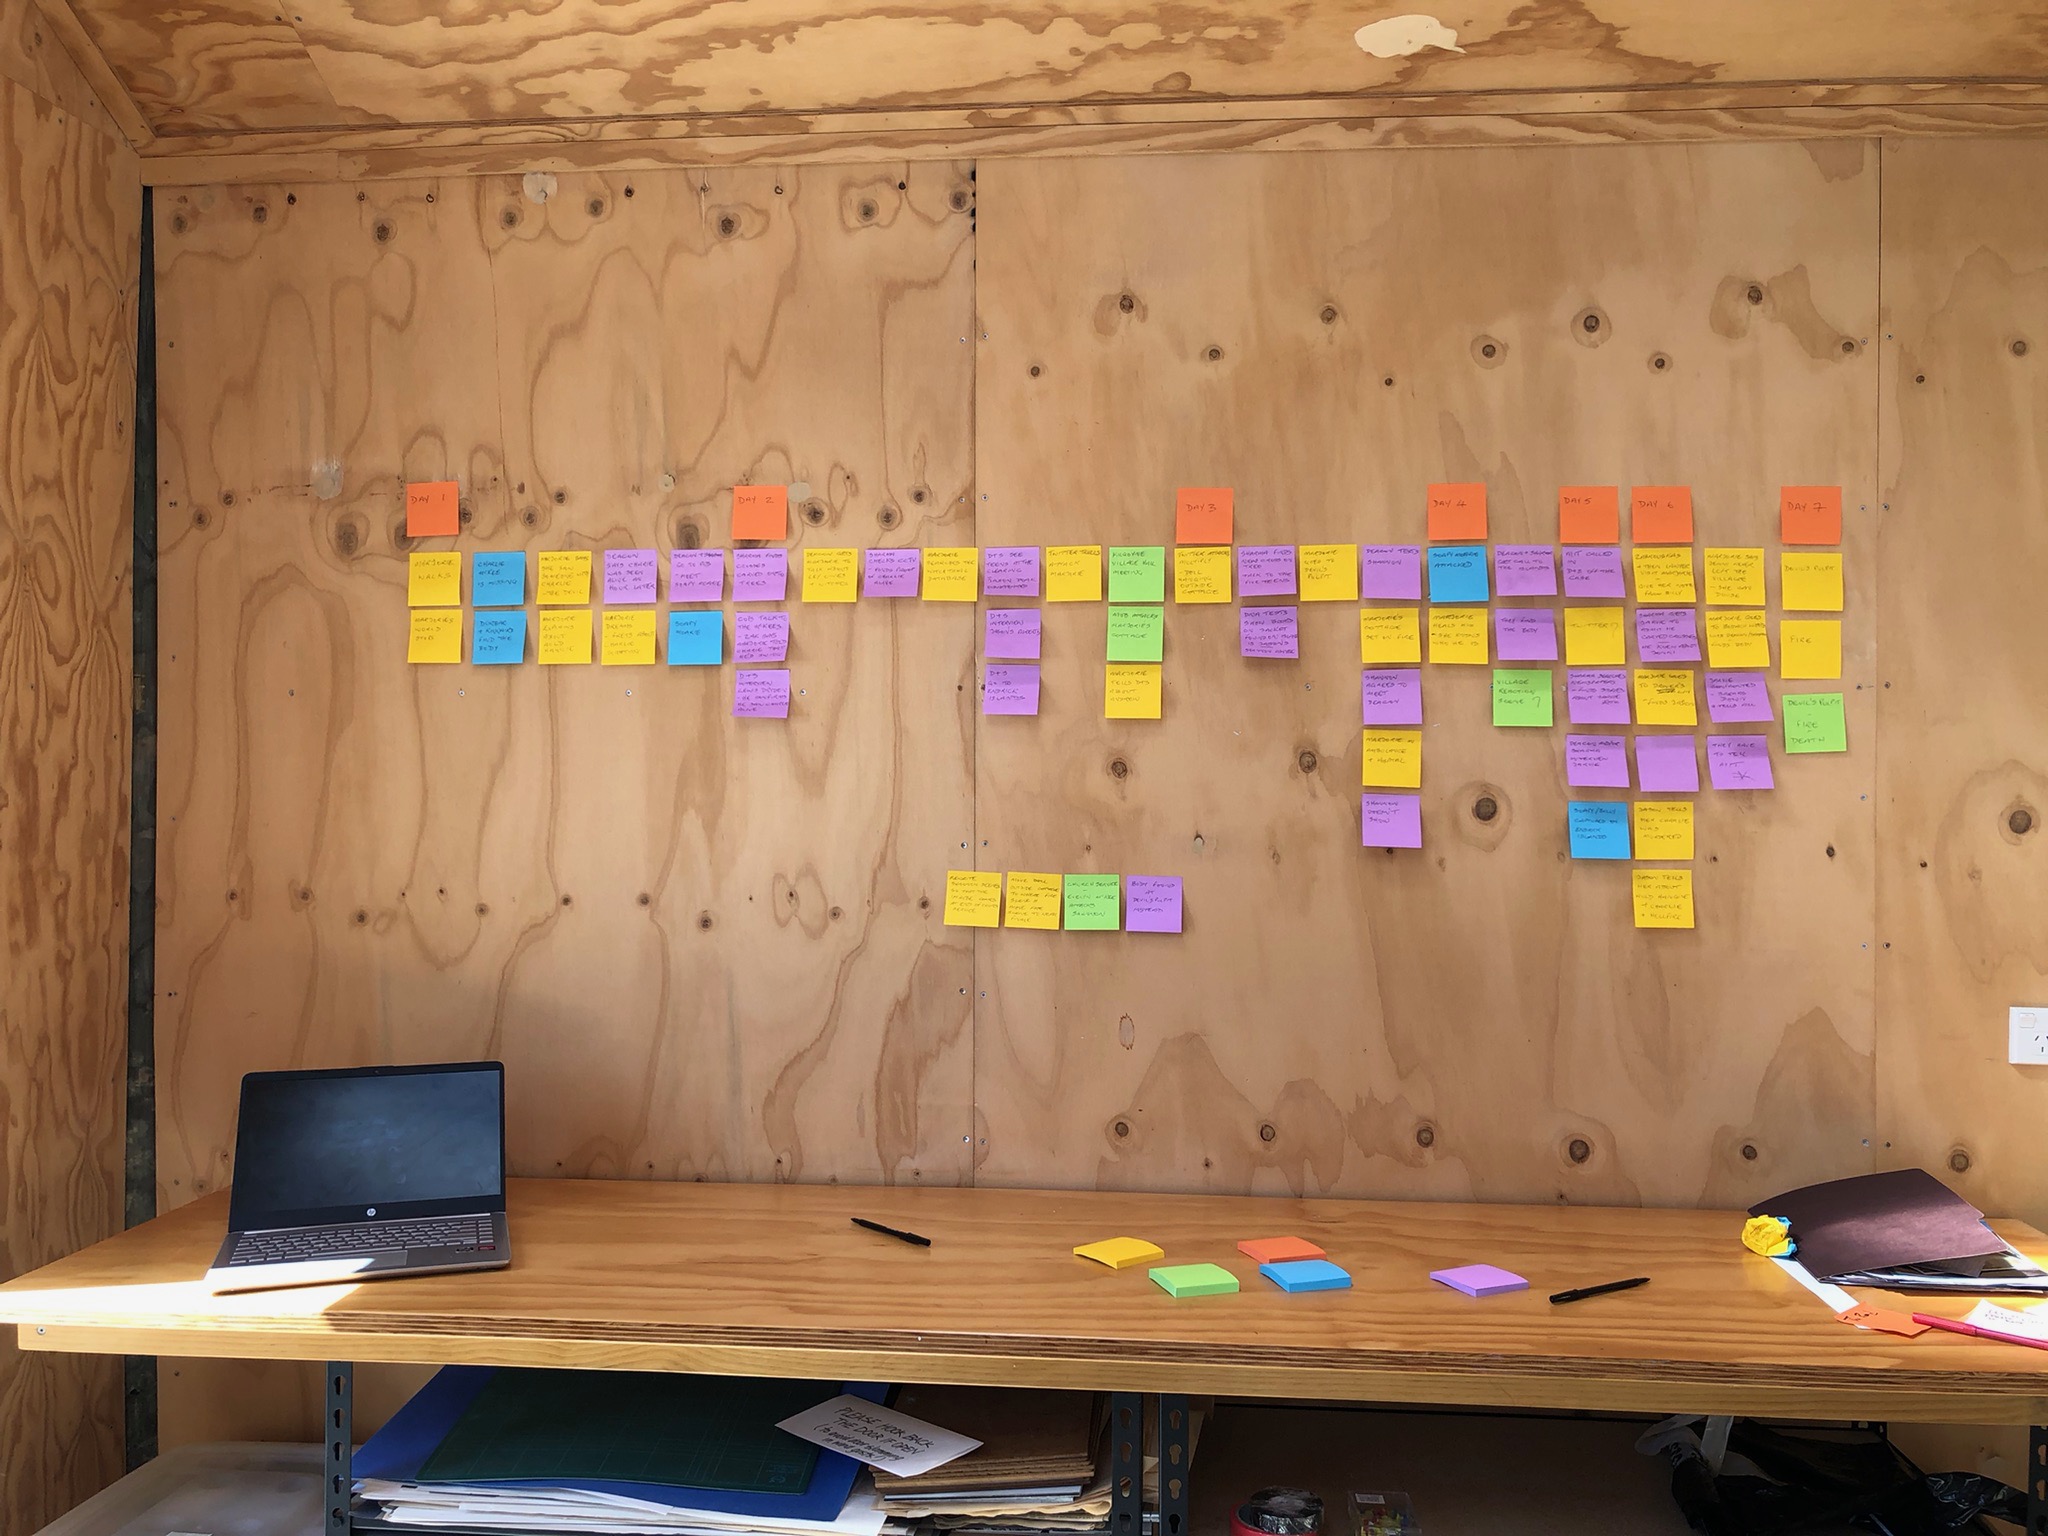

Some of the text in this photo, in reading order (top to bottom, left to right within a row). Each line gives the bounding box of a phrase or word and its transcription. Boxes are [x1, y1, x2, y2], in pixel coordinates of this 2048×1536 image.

[410, 495, 429, 504] DAY
[738, 496, 774, 504] DAY 2
[1433, 499, 1467, 508] DAY 4
[1564, 496, 1592, 505] DAY 5
[1186, 502, 1216, 512] DAY 3
[1639, 500, 1657, 509] DAY
[1788, 501, 1826, 512] DAY 7
[633, 582, 656, 590] LATER
[1789, 634, 1812, 644] FIRE
[1796, 720, 1818, 728] FIRE
[834, 1407, 935, 1448] PLEASE HOOK BACK
[828, 1431, 855, 1441] avoid
[847, 1439, 870, 1447] door
[833, 1417, 858, 1429] THE
[853, 1426, 884, 1440] DOOR
[891, 1442, 926, 1454] OPEN
[832, 1440, 856, 1450] wind
